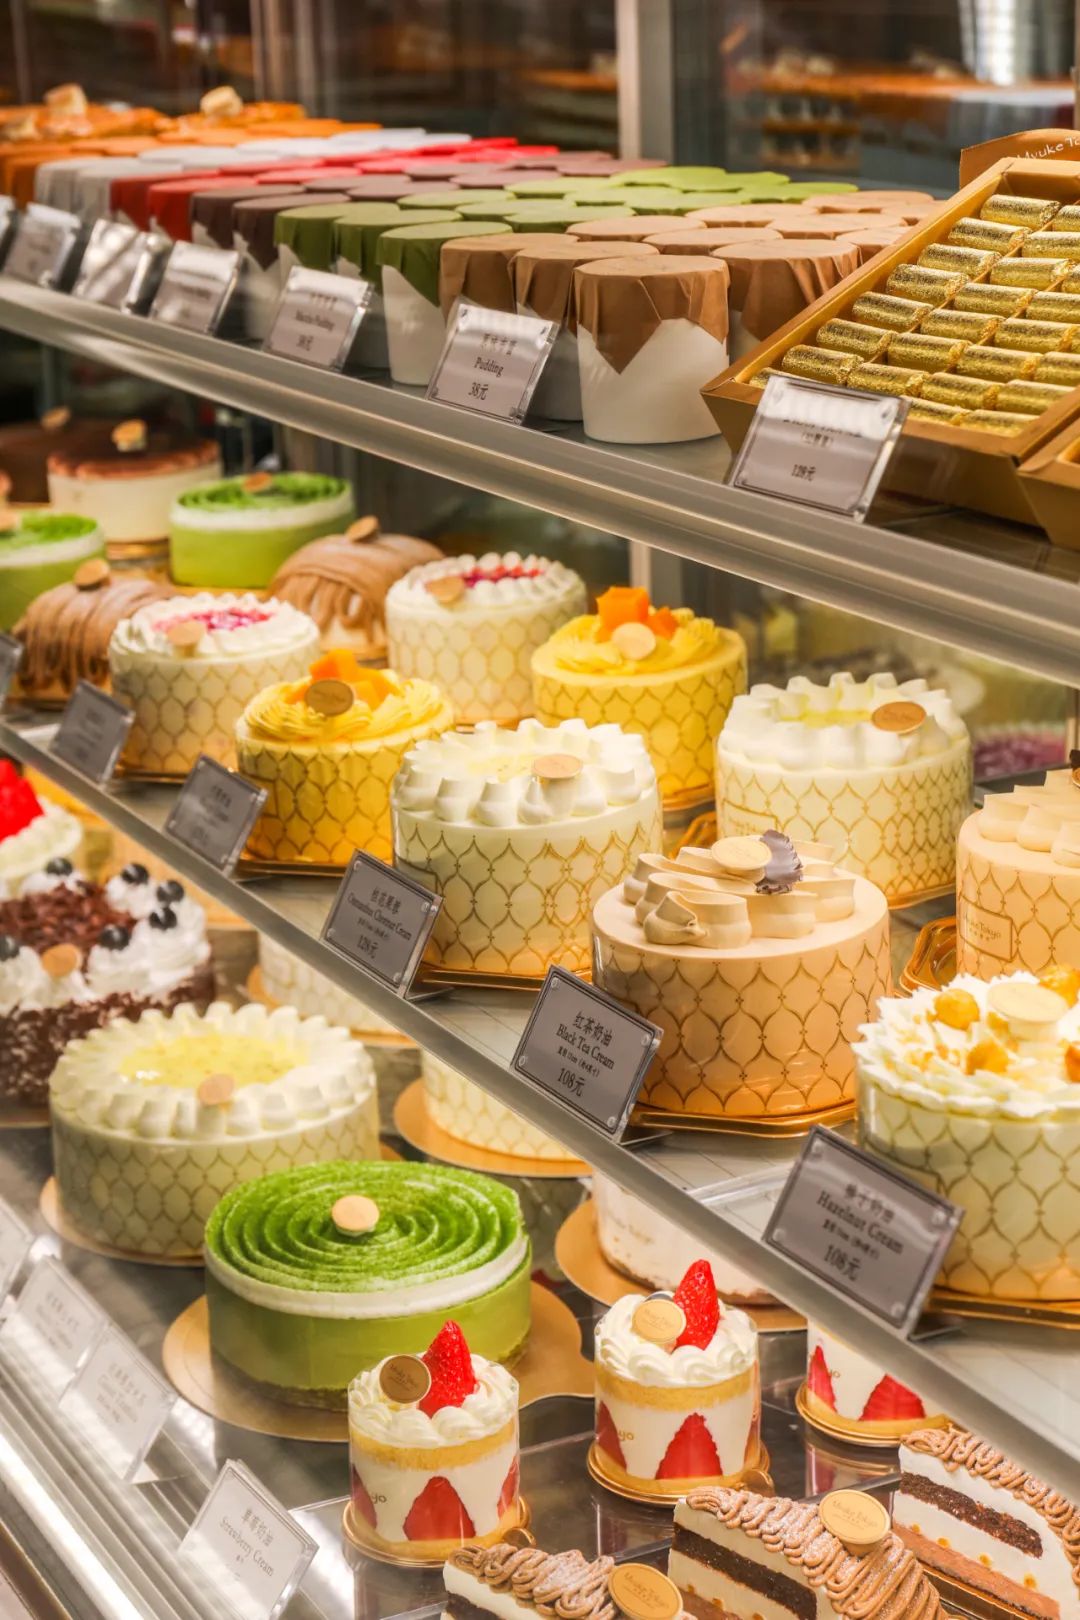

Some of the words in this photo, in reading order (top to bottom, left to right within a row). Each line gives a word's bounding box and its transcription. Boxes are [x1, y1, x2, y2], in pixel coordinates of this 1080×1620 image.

[474, 356, 504, 378] Pudding
[468, 382, 489, 401] 38元
[556, 1023, 577, 1046] Black
[577, 1035, 591, 1055] Tea
[591, 1046, 615, 1070] Cream
[572, 1010, 613, 1047] 红茶奶油
[557, 1067, 585, 1097] 108元
[816, 1190, 867, 1232] Hazelnut
[867, 1223, 904, 1255] Cream
[823, 1244, 861, 1282] 108元
[219, 1516, 254, 1558] Strawberry
[253, 1550, 275, 1577] Cream
